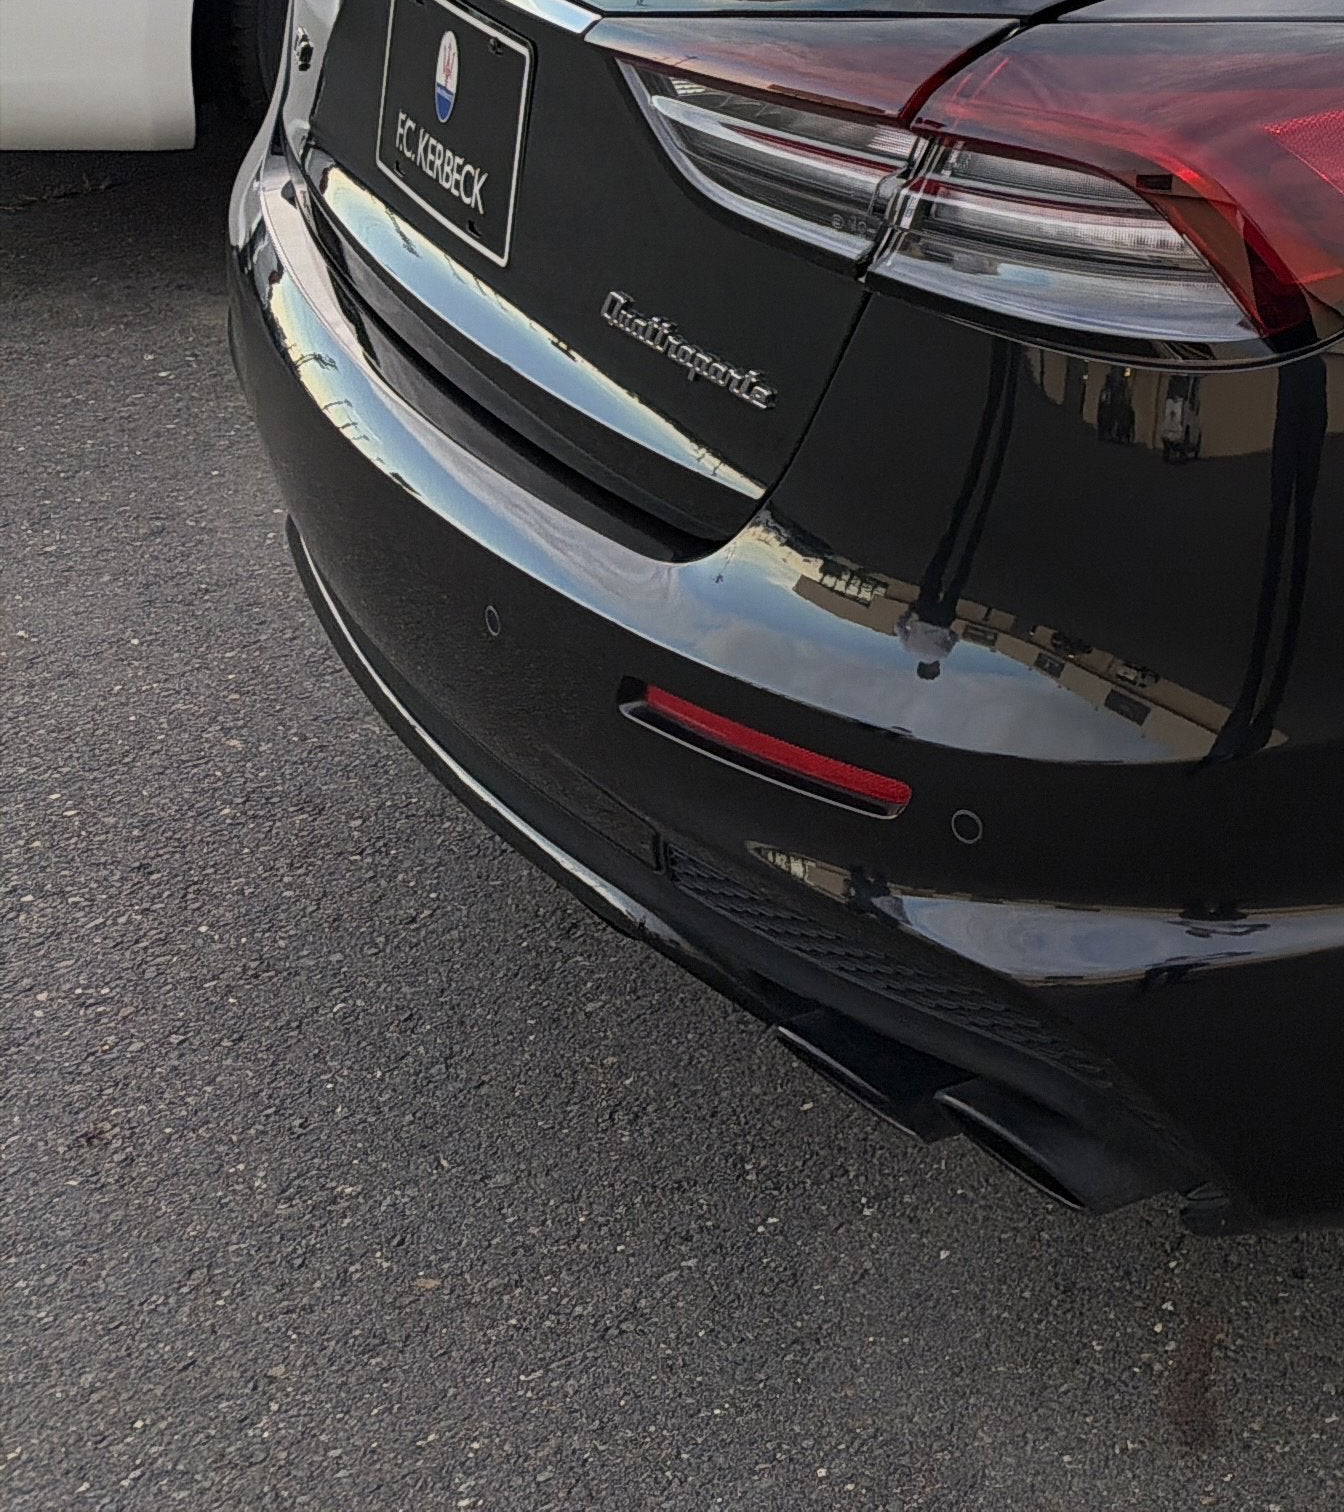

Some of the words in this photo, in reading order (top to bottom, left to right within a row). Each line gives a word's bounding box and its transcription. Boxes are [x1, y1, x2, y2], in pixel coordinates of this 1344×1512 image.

[396, 111, 417, 162] F.C.
[416, 128, 489, 215] KERBECK
[601, 291, 778, 409] Quattroporte
